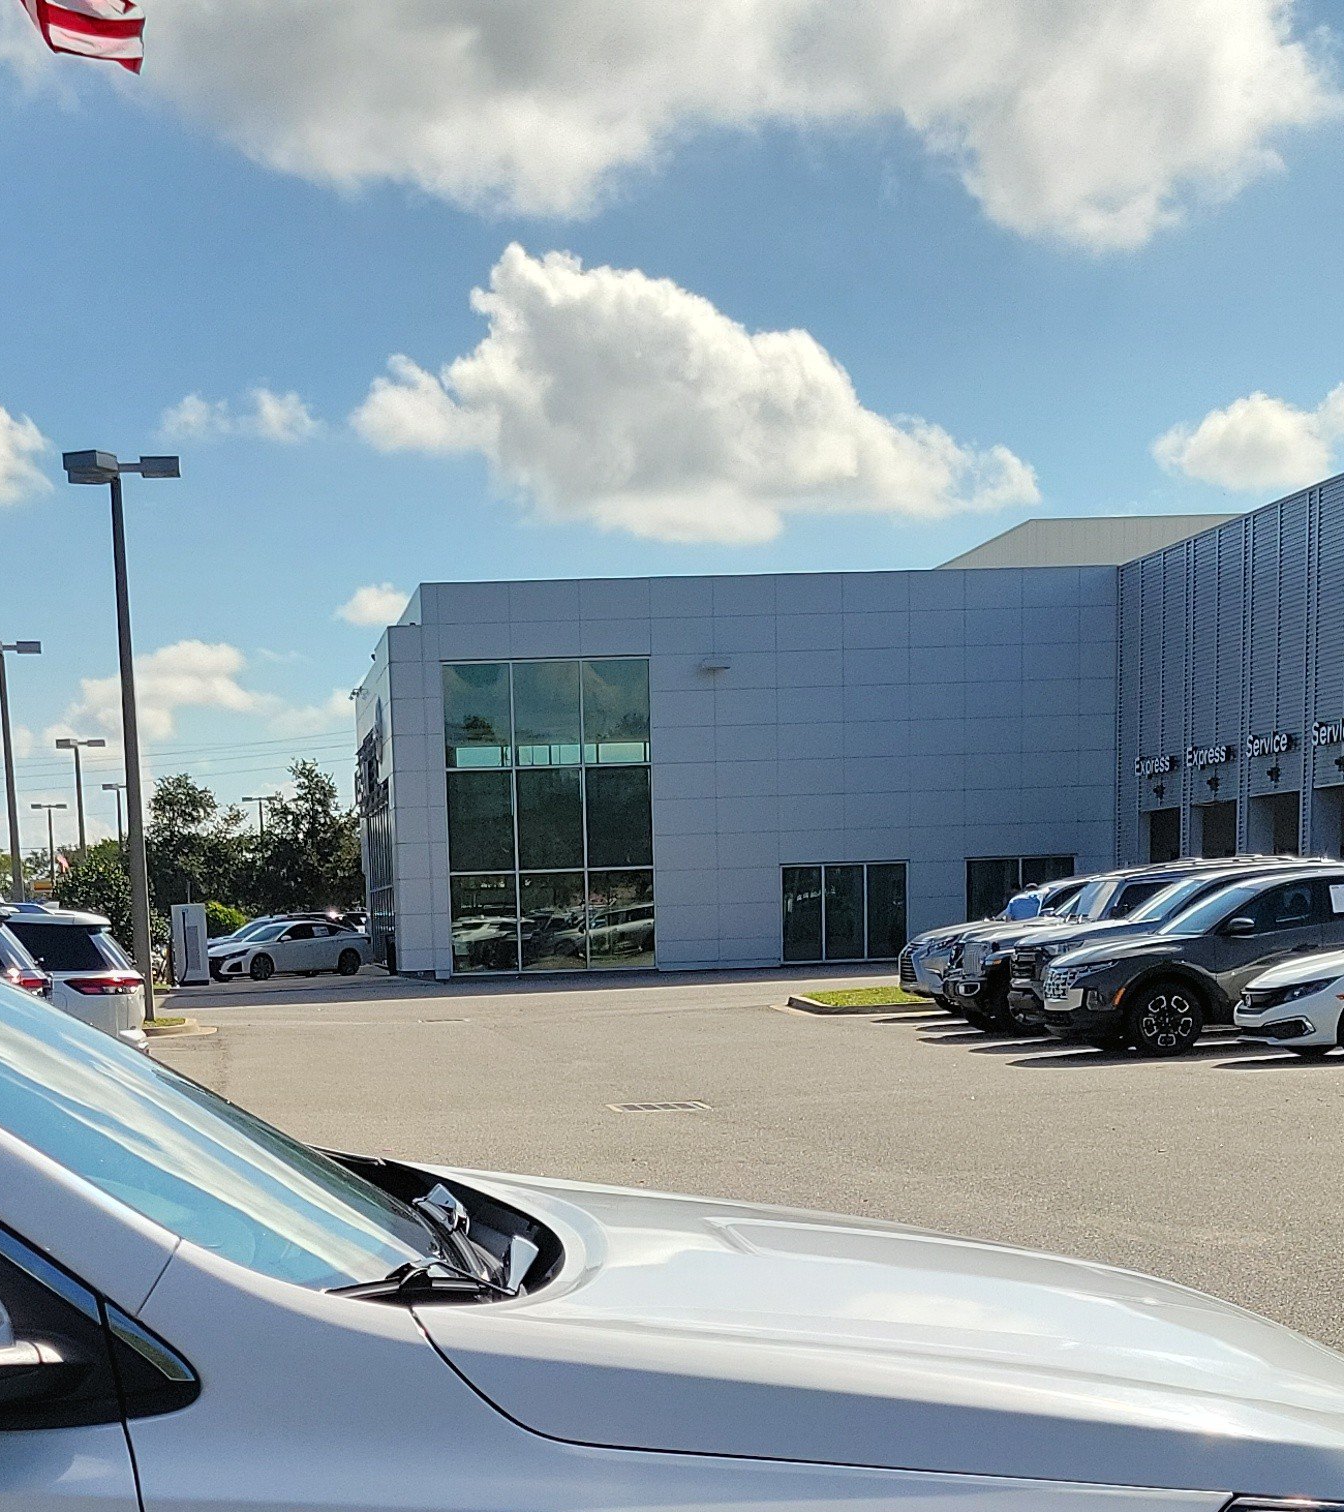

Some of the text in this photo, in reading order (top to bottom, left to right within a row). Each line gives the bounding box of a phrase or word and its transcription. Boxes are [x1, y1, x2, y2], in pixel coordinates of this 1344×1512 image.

[1245, 730, 1288, 758] Service
[1134, 756, 1170, 778] Express
[1186, 745, 1227, 770] Express
